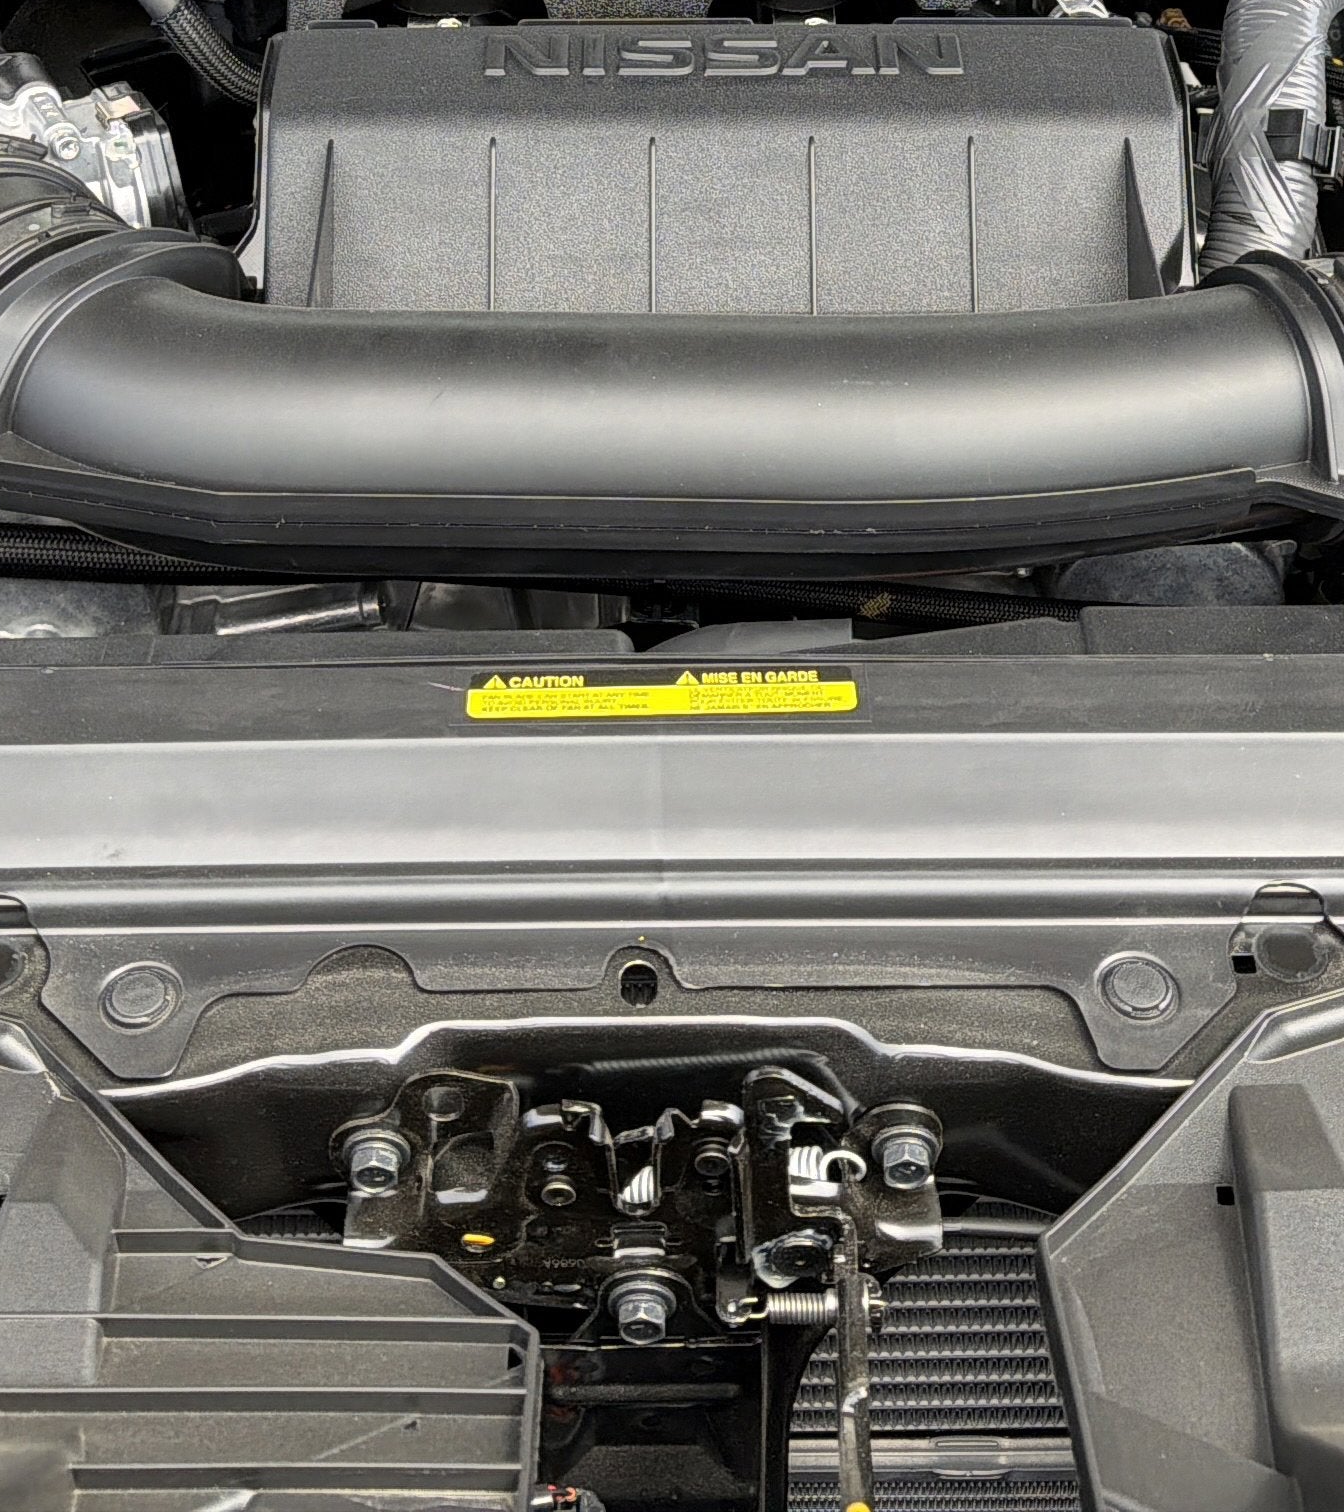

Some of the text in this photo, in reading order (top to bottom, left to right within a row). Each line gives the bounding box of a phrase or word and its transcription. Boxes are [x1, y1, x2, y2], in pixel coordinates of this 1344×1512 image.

[484, 34, 964, 76] NISSAN
[508, 675, 585, 688] CAUTION
[701, 670, 819, 684] MISE EN GARDE
